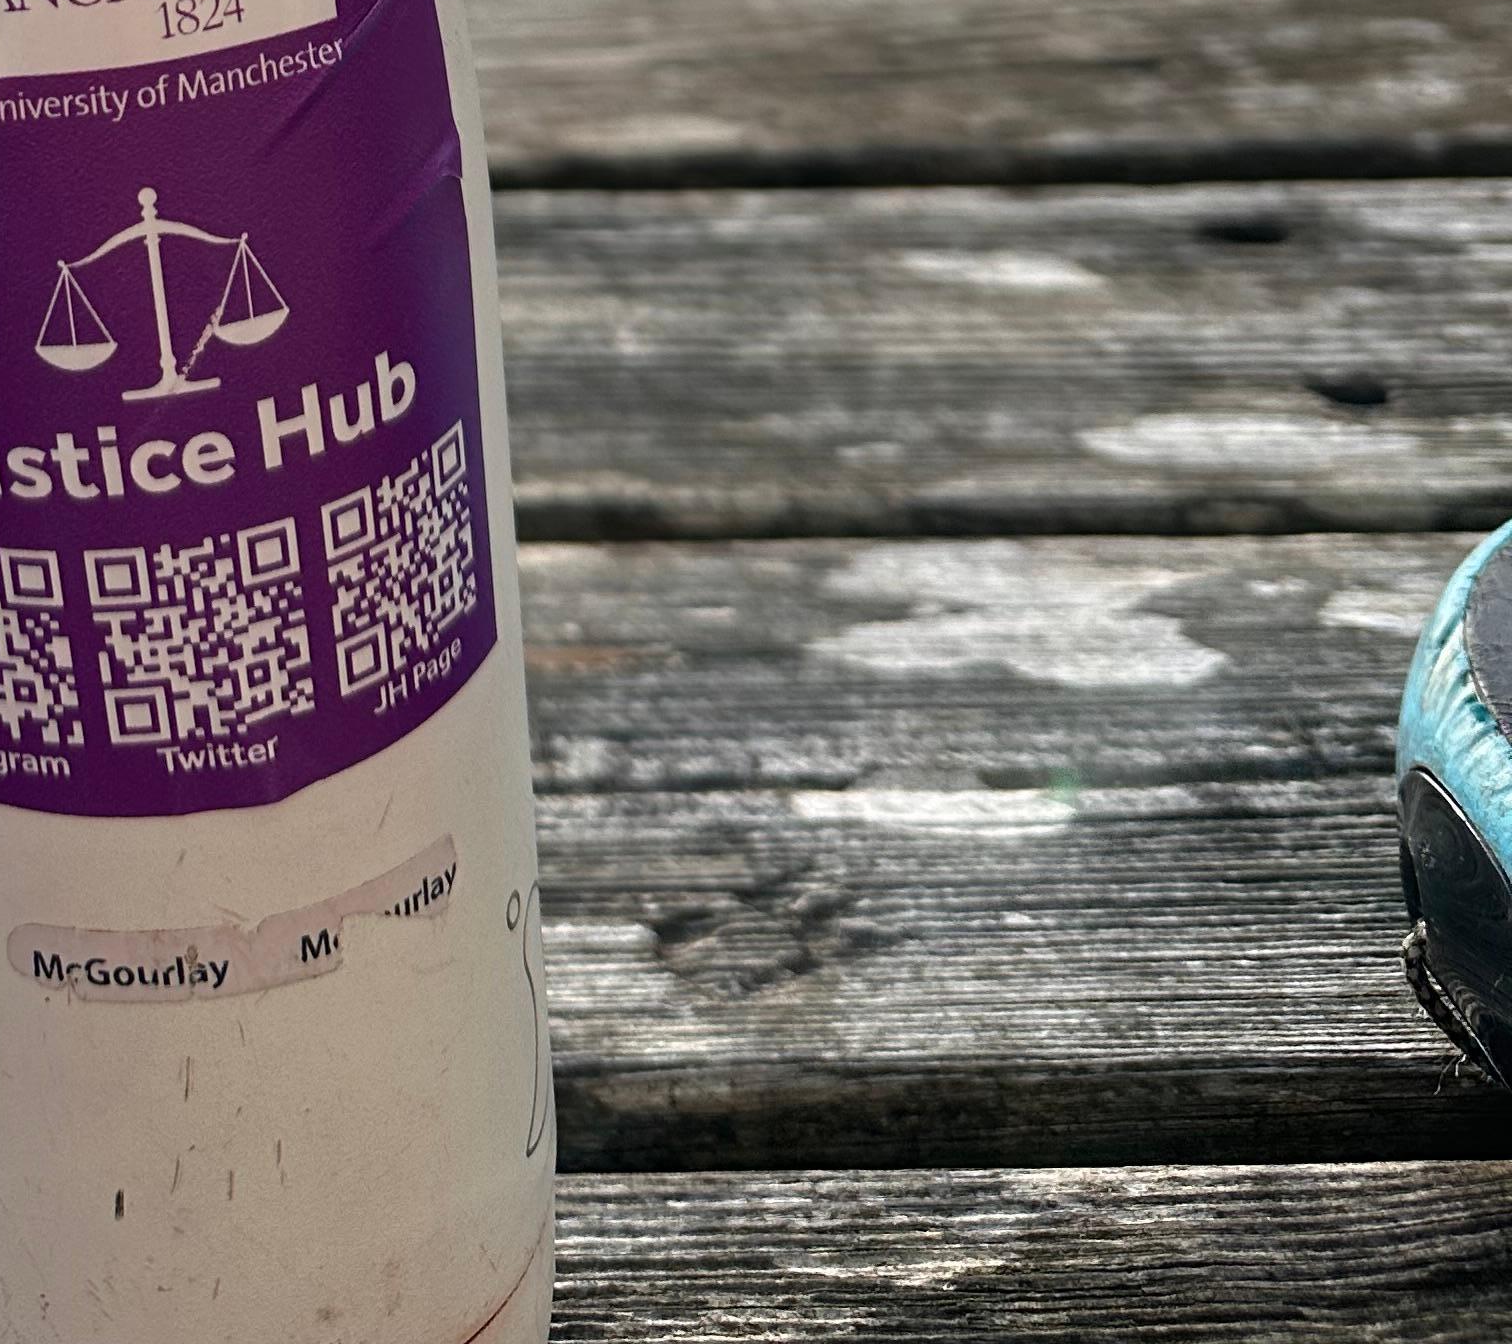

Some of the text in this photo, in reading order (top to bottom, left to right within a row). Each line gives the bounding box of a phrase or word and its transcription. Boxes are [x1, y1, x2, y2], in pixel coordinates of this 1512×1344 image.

[137, 75, 170, 109] of
[178, 38, 345, 102] Manchester
[257, 351, 417, 469] Hub
[374, 637, 462, 715] JH Page
[156, 735, 278, 774] Twitter
